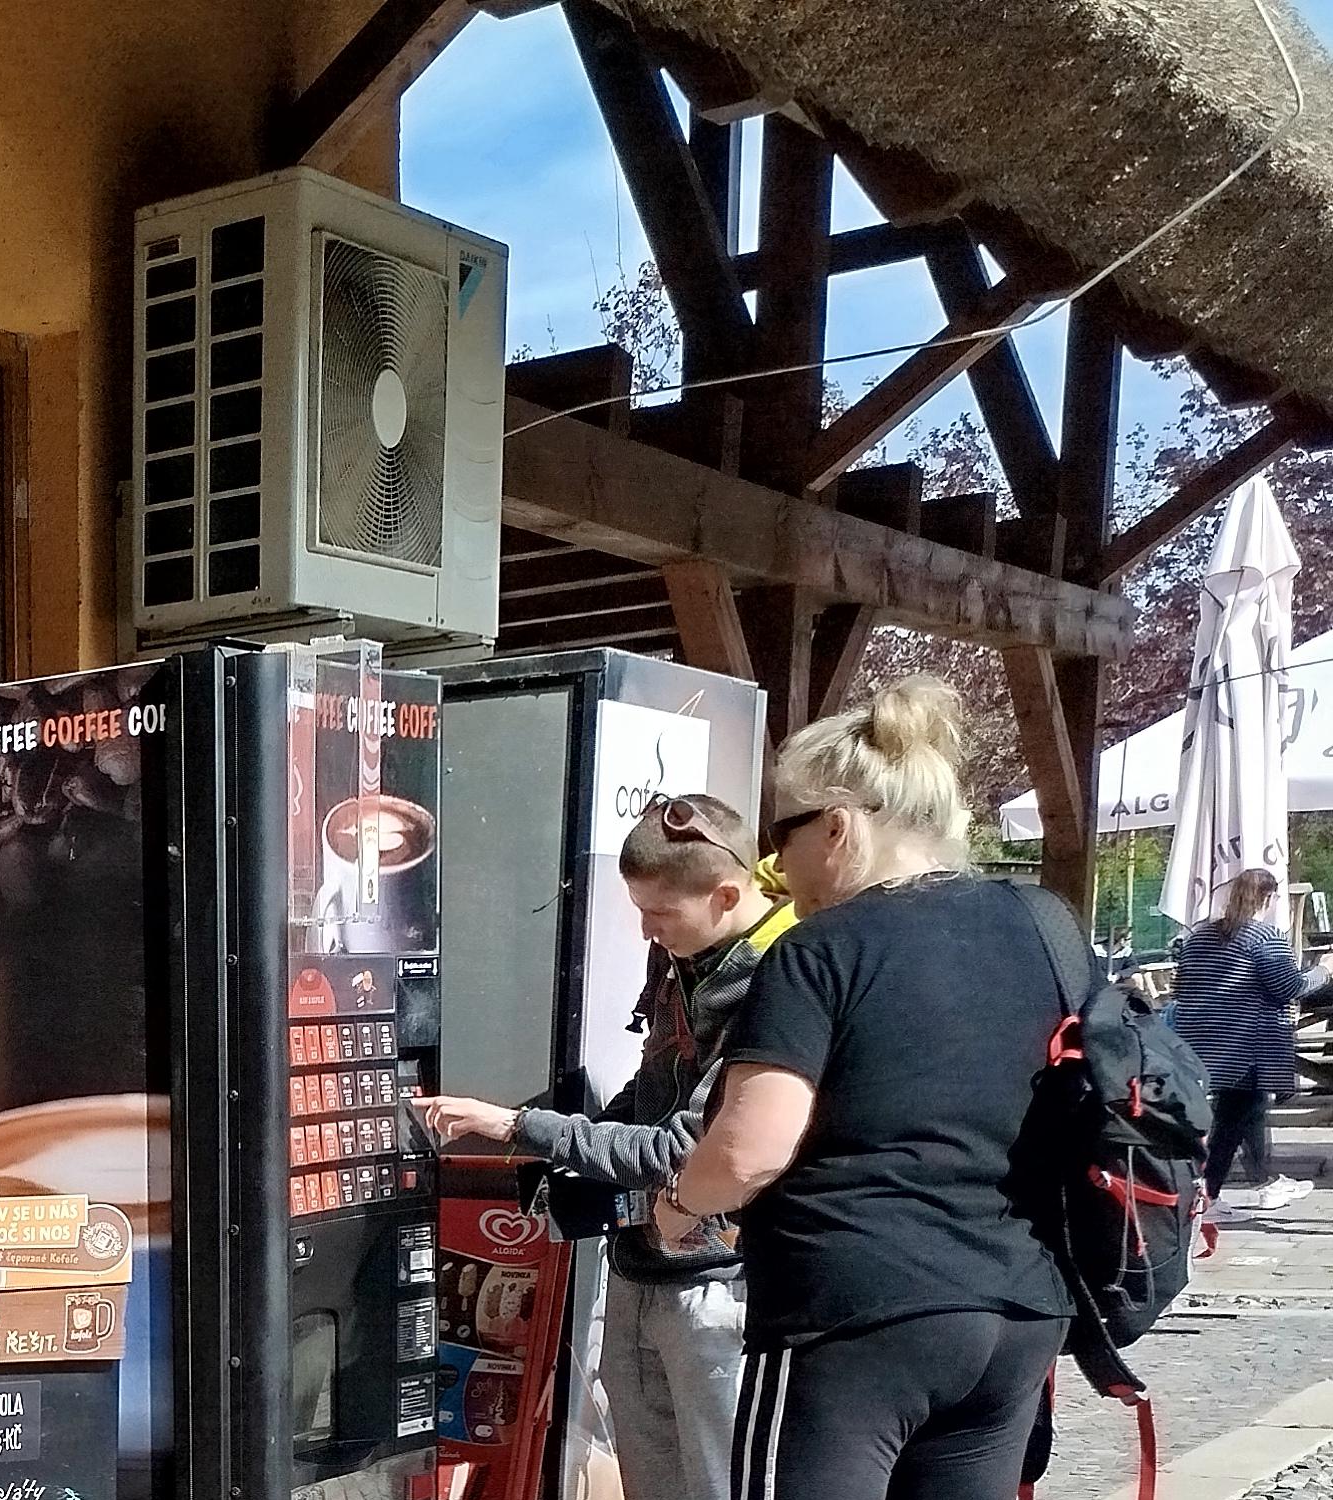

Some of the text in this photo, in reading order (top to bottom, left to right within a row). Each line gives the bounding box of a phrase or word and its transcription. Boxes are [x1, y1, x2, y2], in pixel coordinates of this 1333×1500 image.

[43, 708, 122, 747] COFFEE
[616, 779, 657, 819] caf
[12, 1206, 31, 1221] SE
[34, 1206, 46, 1220] U
[48, 1200, 79, 1220] NÁS
[22, 1226, 35, 1242] SI
[40, 1225, 71, 1241] NOS
[492, 1247, 524, 1256] ALGIDA
[6, 1330, 58, 1354] ŘEŠIT.
